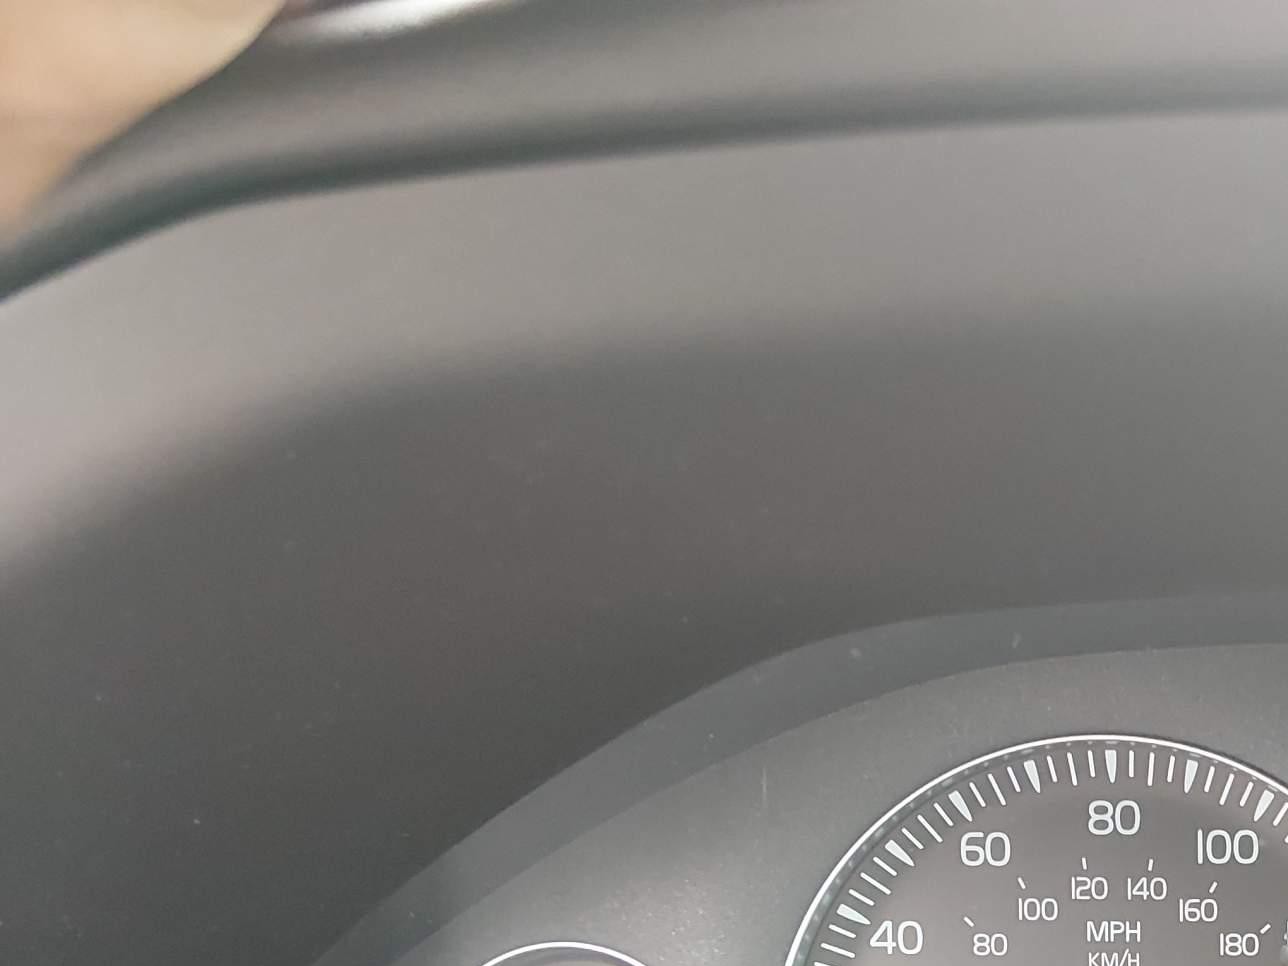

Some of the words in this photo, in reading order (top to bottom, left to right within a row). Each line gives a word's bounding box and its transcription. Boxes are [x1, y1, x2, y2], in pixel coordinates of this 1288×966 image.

[1087, 800, 1141, 836] 80
[960, 832, 1010, 866] 60
[1196, 829, 1259, 864] 100
[1071, 877, 1108, 900] 120
[1127, 877, 1167, 900] 140
[1018, 898, 1058, 921] 100
[1178, 899, 1218, 922] 160
[869, 920, 923, 955] 40
[1086, 921, 1141, 943] MPH
[972, 933, 1008, 956] 80
[1219, 933, 1259, 956] 180
